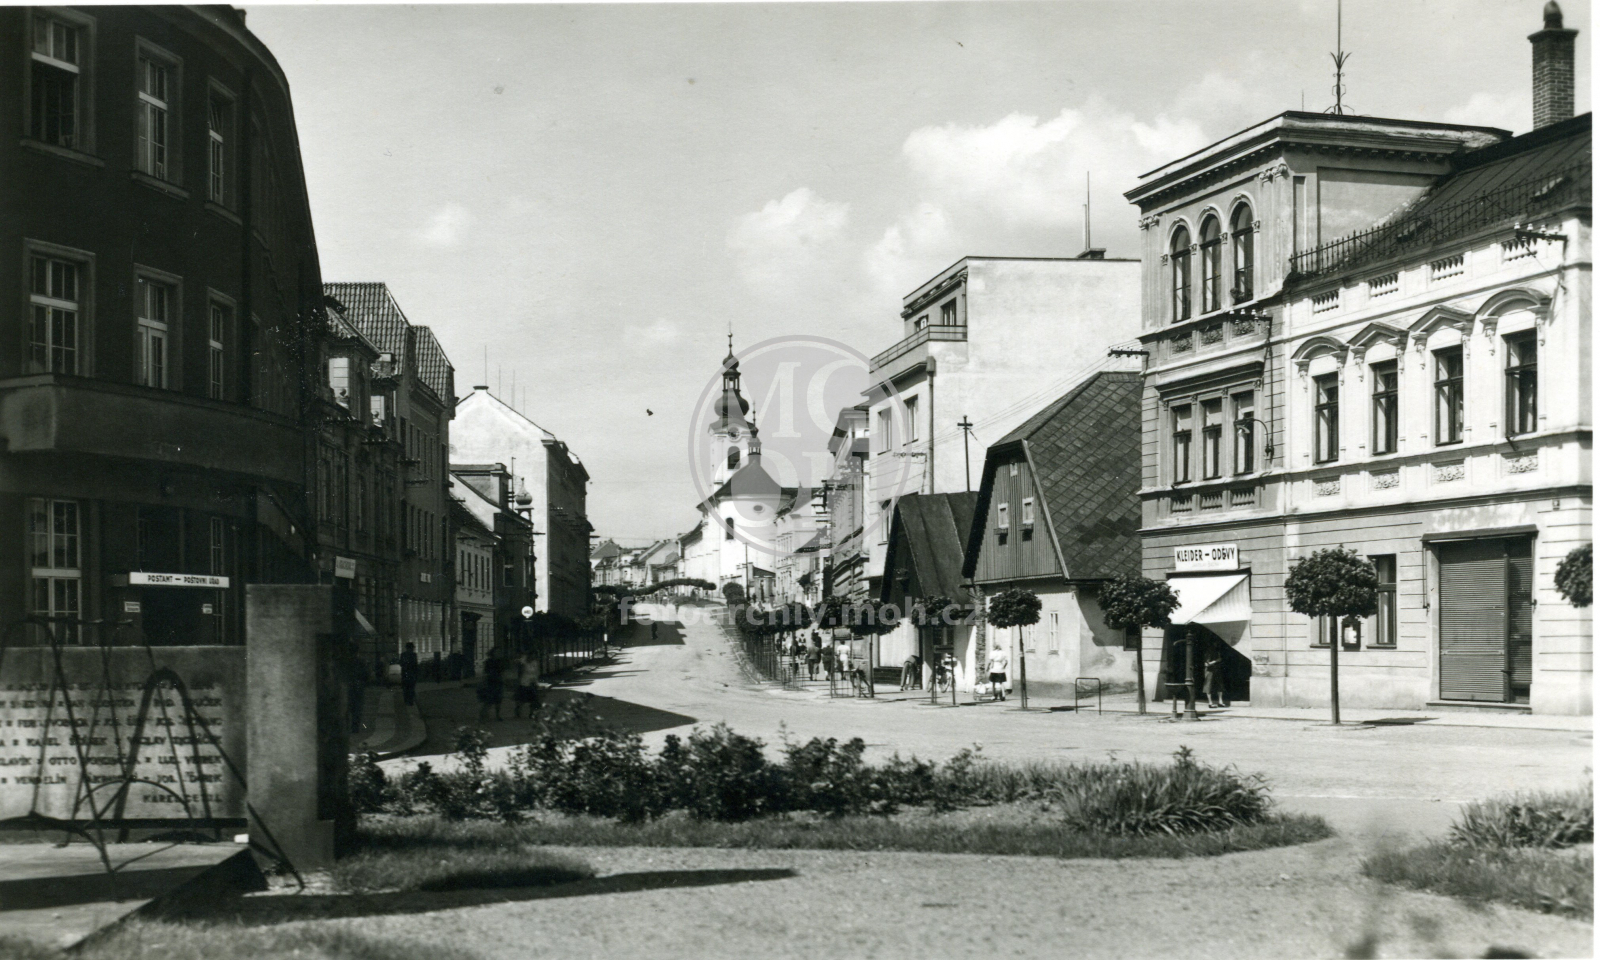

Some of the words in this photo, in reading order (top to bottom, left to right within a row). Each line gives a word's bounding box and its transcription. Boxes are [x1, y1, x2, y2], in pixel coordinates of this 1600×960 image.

[1176, 549, 1203, 562] KLEIDER
[1212, 546, 1235, 561] ODĚVY
[148, 574, 173, 583] POSTAMT
[49, 756, 77, 766] OTTO
